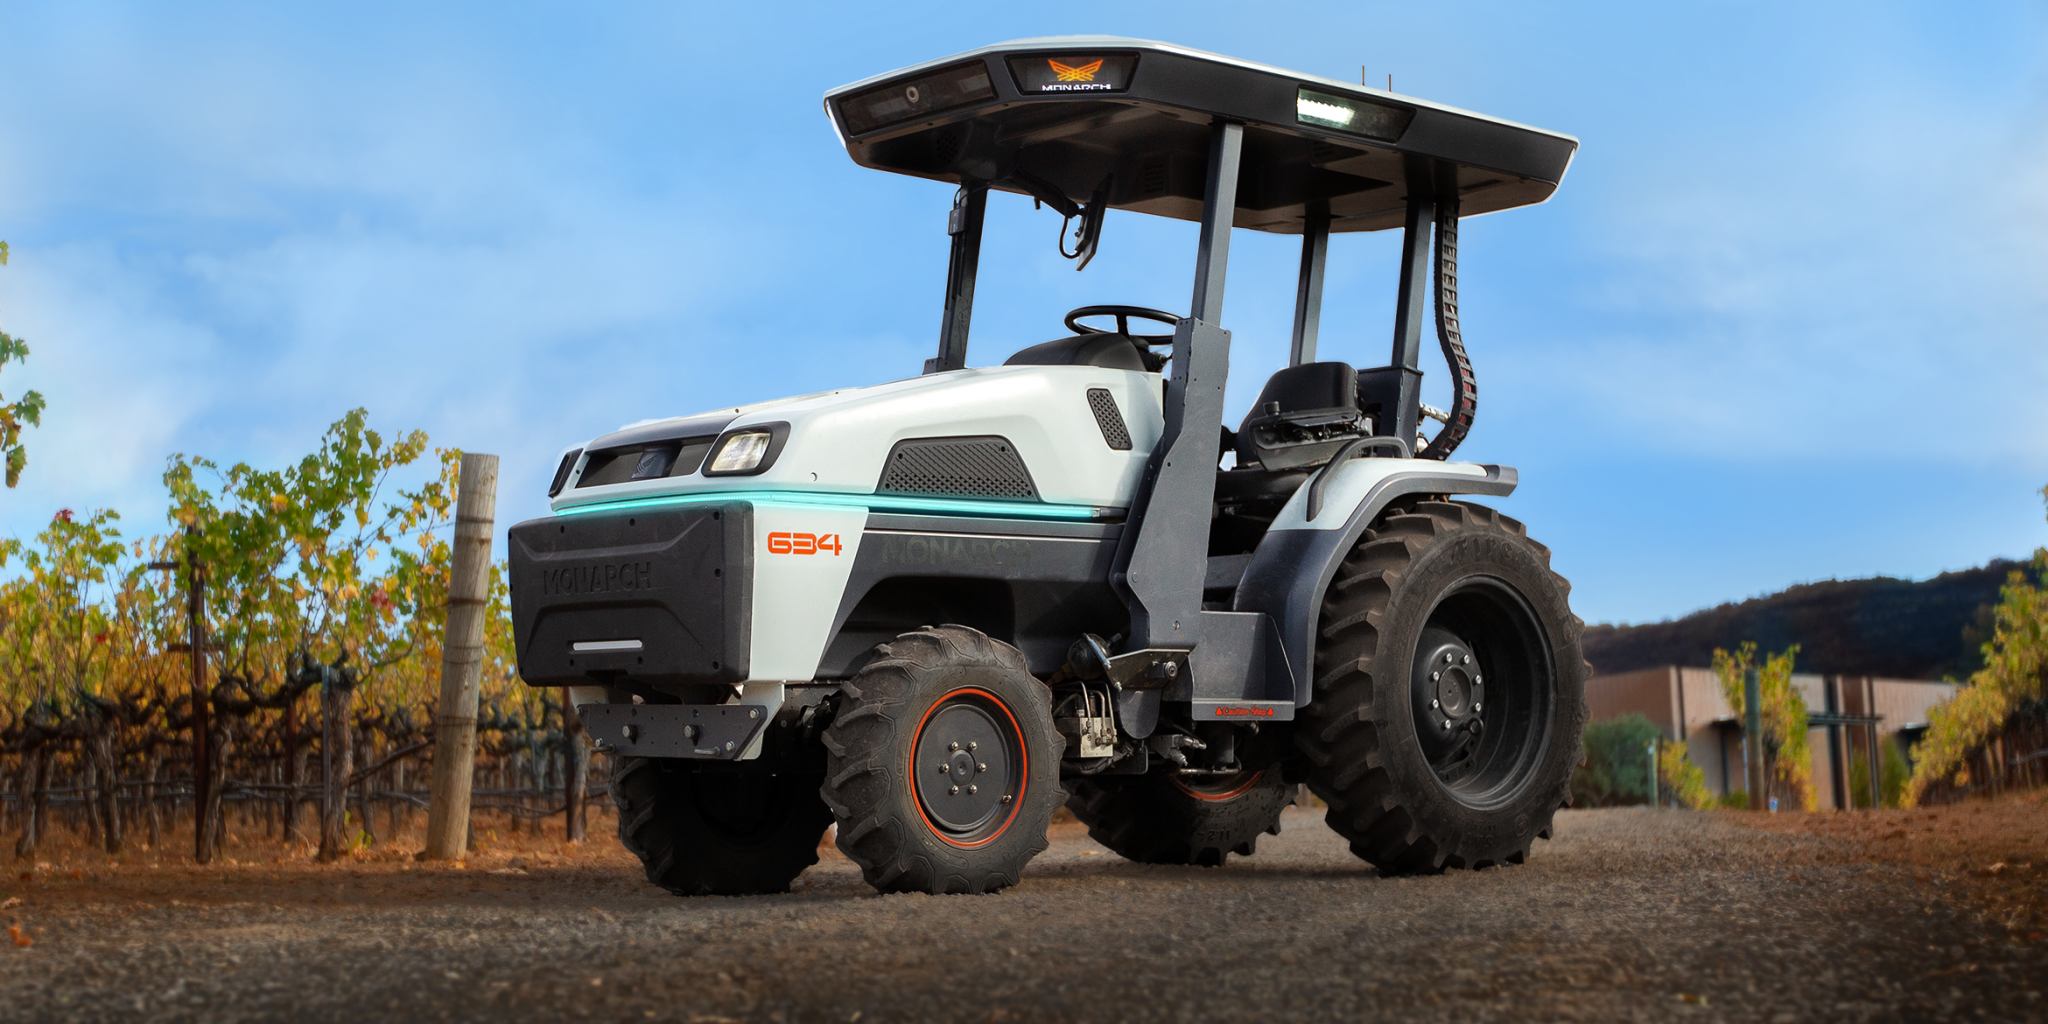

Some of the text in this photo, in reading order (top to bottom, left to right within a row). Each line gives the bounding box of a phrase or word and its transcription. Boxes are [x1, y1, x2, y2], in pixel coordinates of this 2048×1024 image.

[1042, 83, 1111, 91] MONARCH
[767, 531, 843, 556] 634
[543, 561, 652, 597] MONARCH
